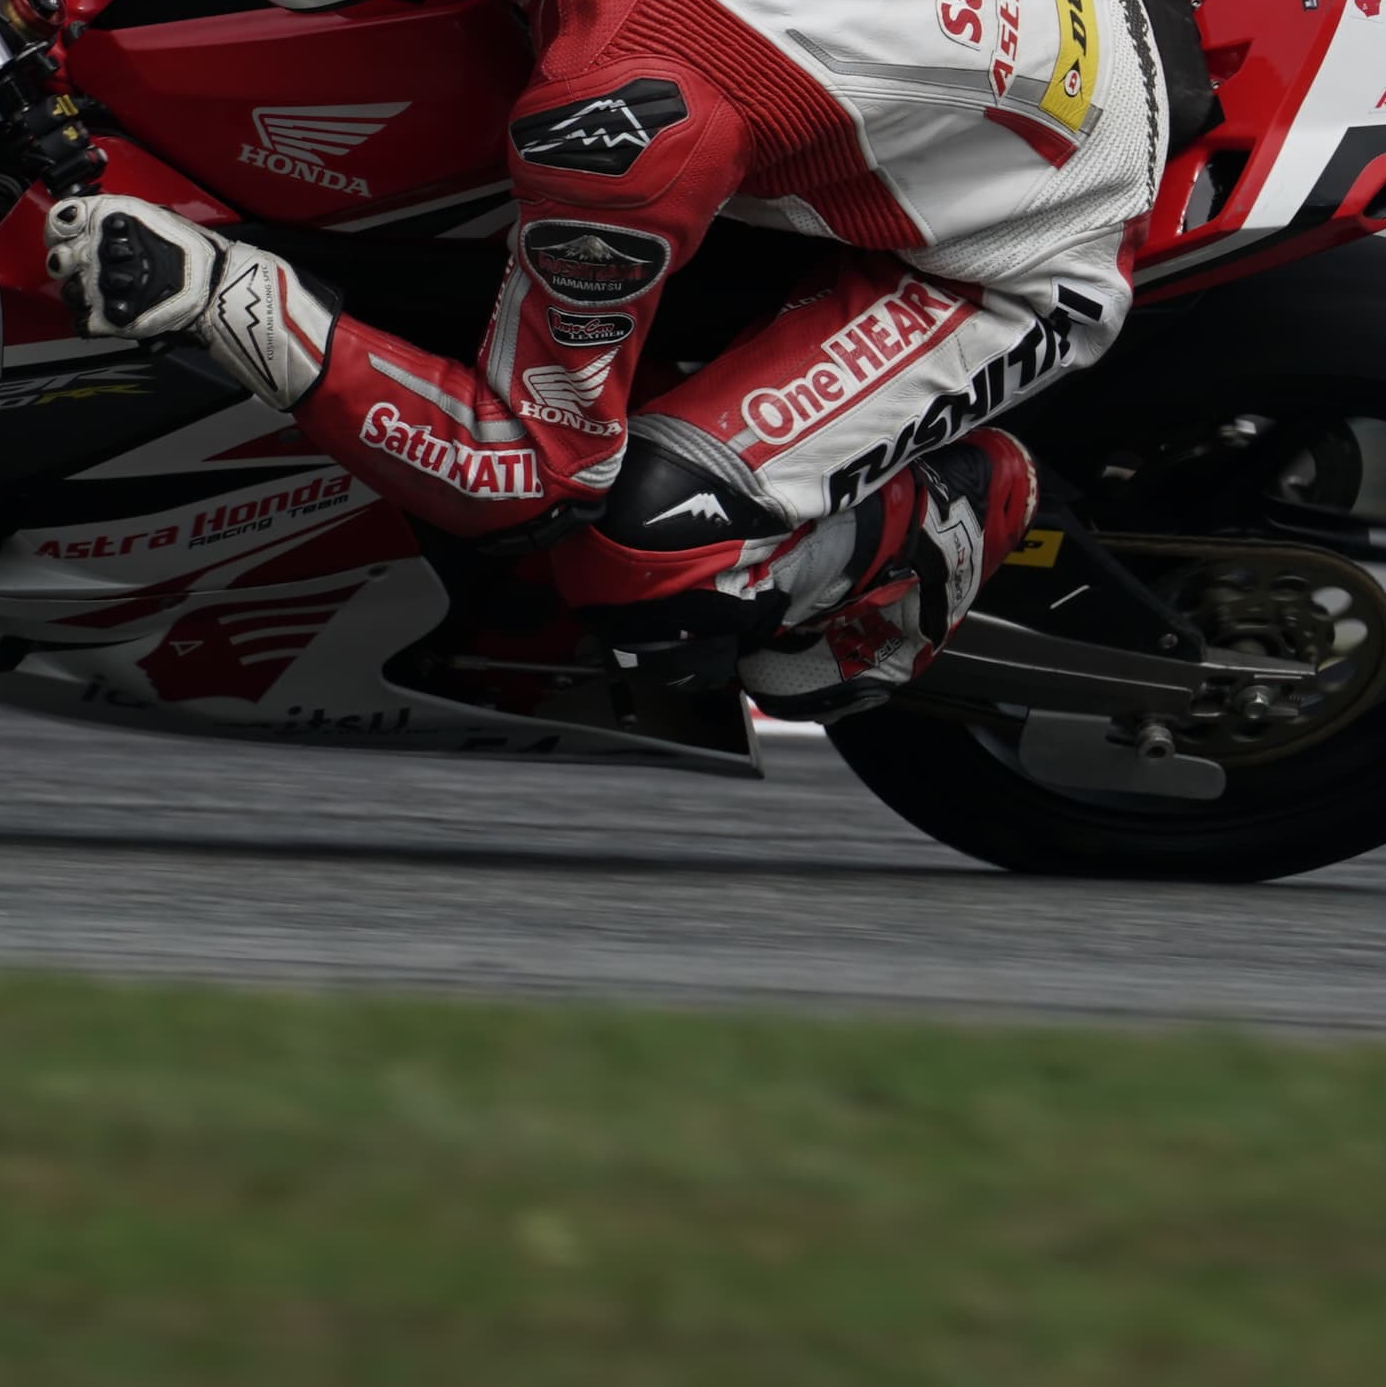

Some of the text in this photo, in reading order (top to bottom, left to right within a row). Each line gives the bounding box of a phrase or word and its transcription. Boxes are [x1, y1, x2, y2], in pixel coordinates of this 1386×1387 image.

[237, 143, 373, 198] HONDA
[264, 286, 274, 315] RACING
[552, 275, 622, 292] HAMAMATSU
[265, 315, 275, 361] KUSHITANI
[748, 369, 845, 440] One
[829, 281, 959, 383] HEAR
[518, 400, 623, 437] HONDA
[363, 406, 543, 494] Satu HATI.
[35, 474, 354, 559] Astra Honda
[188, 495, 350, 551] Racing Team
